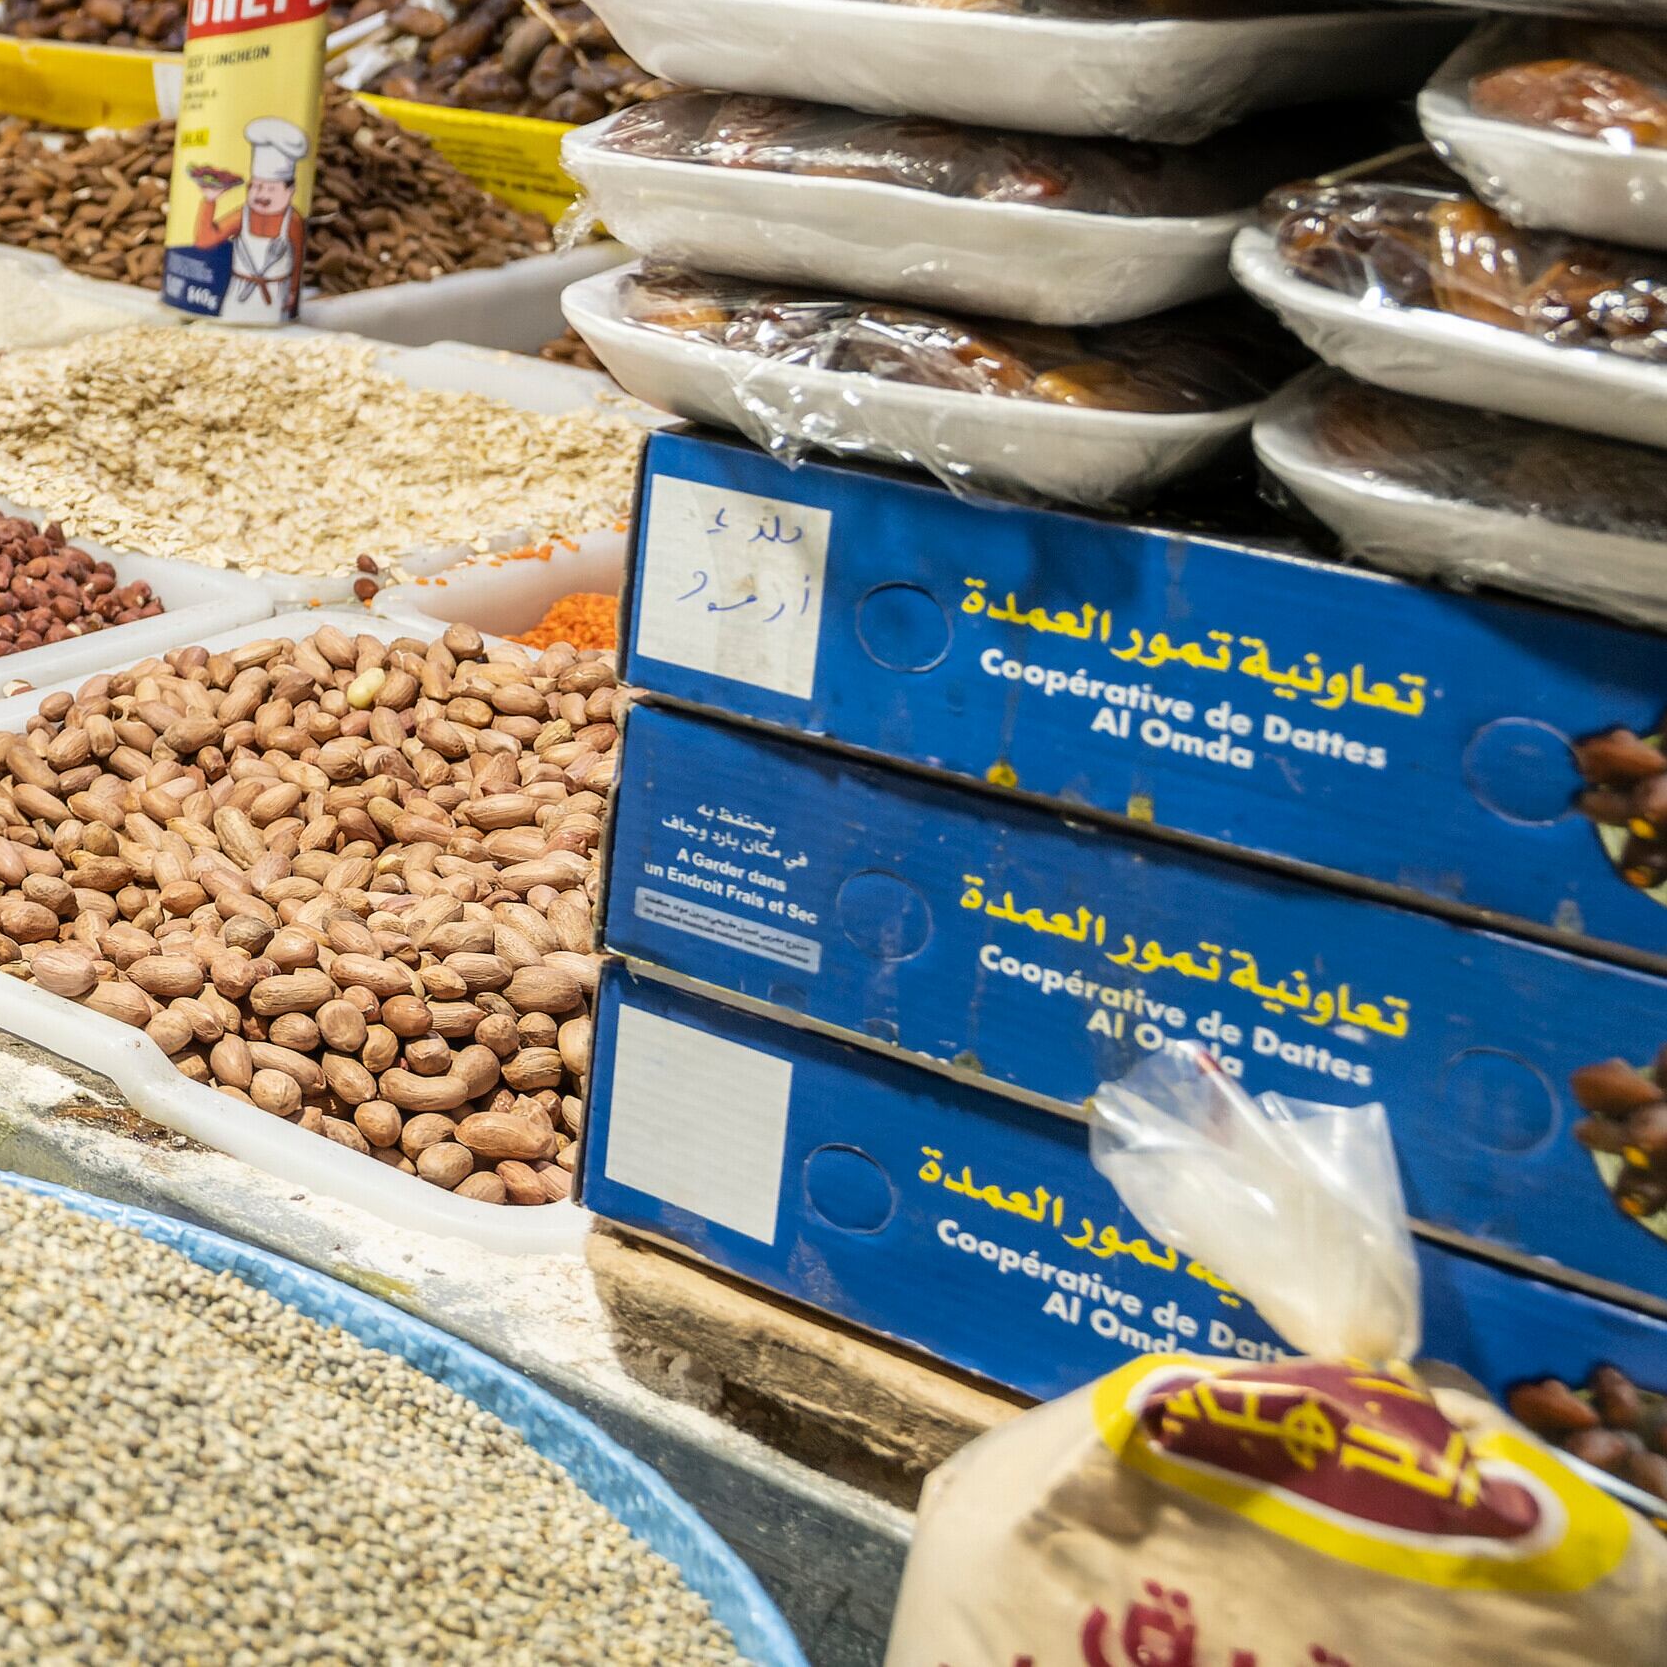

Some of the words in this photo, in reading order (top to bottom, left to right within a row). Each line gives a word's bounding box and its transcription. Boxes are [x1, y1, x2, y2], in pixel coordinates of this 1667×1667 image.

[960, 577, 1113, 643] العمدة
[1110, 628, 1234, 672] تمور
[1238, 634, 1428, 718] تعاونية
[980, 647, 1195, 724] Coopérative
[1203, 700, 1254, 736] de
[1263, 712, 1388, 771] Dattes
[1090, 705, 1131, 740] Al
[1138, 716, 1255, 771] Omda
[643, 861, 665, 878] un
[667, 866, 724, 896] Endroit
[725, 883, 765, 910] Frais
[768, 898, 785, 916] et
[786, 902, 818, 926] Sec
[676, 847, 690, 864] A
[691, 851, 746, 880] Garder
[747, 869, 788, 893] dans
[959, 873, 1106, 946] العمدة
[1104, 934, 1223, 982] تمور
[979, 943, 1187, 1029] Coopérative
[1195, 1009, 1243, 1047] de
[1251, 1025, 1373, 1088] Dattes
[1086, 1006, 1125, 1040] Al
[1228, 948, 1410, 1039] تعاونية
[918, 1145, 1064, 1228] العمدة
[936, 1218, 1144, 1318] Coopérative
[1151, 1301, 1199, 1337] de
[1041, 1291, 1081, 1325] Al
